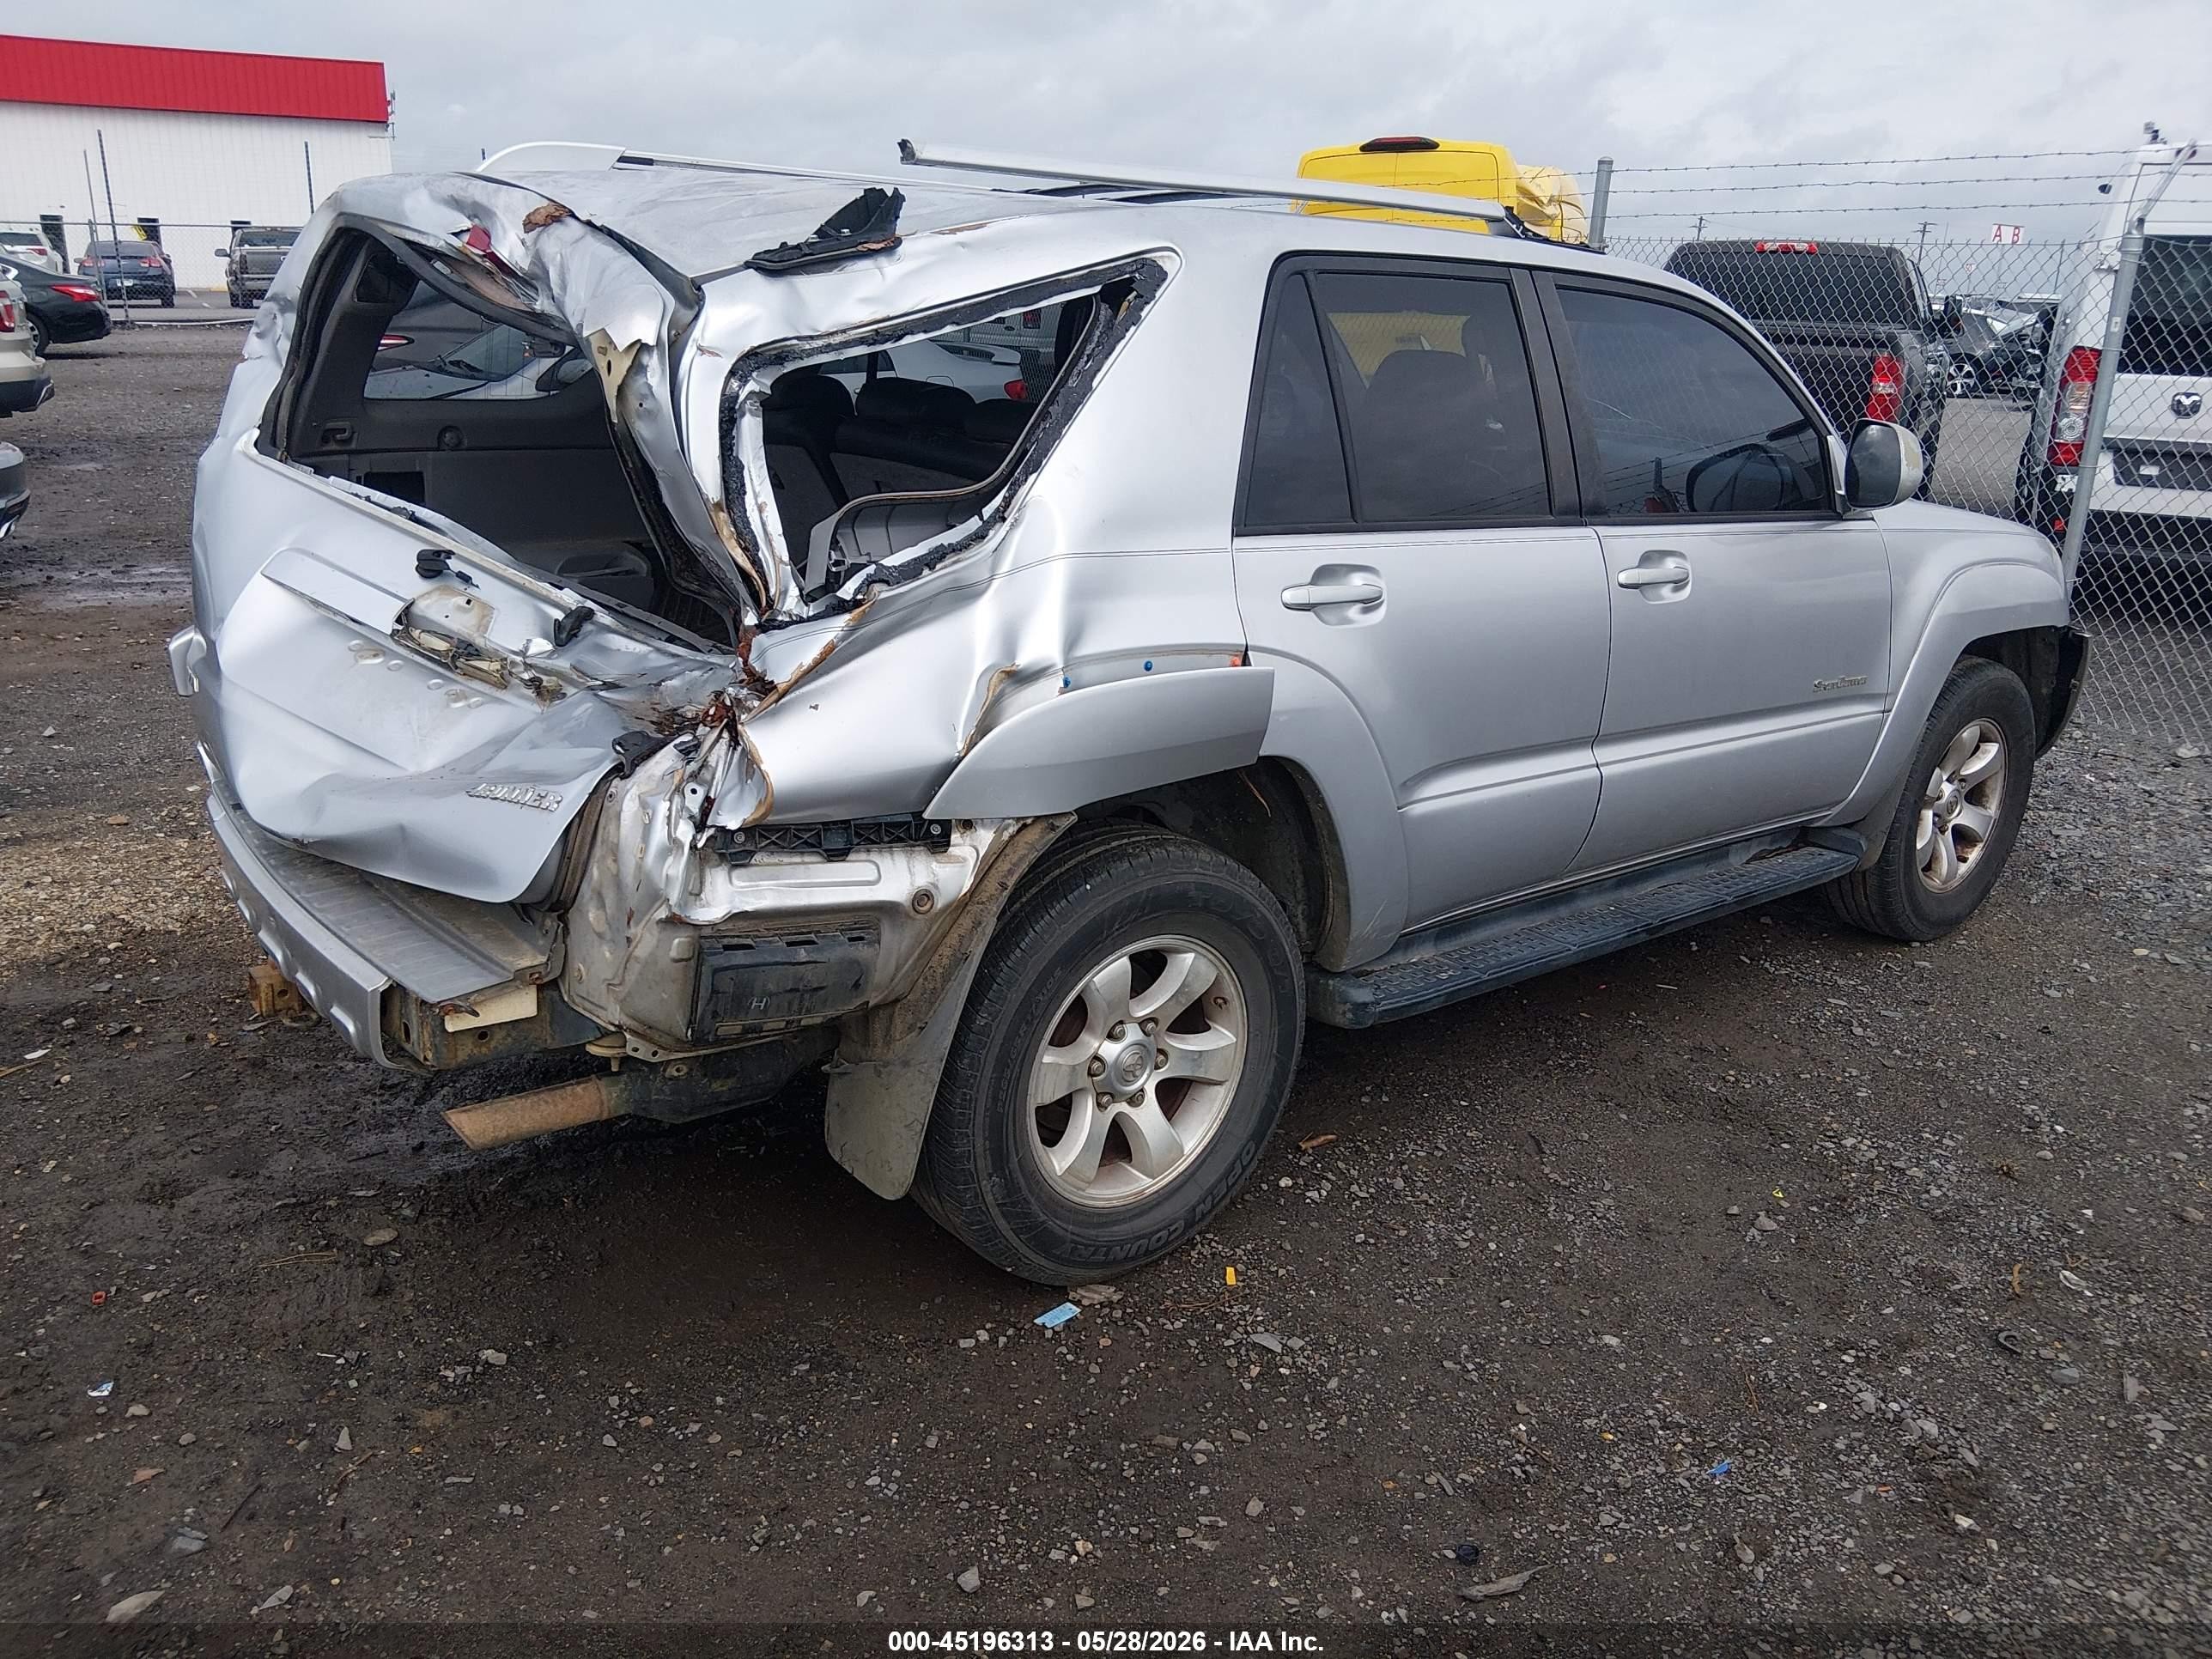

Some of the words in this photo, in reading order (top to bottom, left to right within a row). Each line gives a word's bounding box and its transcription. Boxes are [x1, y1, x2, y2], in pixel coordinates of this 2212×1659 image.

[1992, 224, 2002, 243] A
[2011, 226, 2021, 245] B
[1194, 1140, 1256, 1221] OPEN
